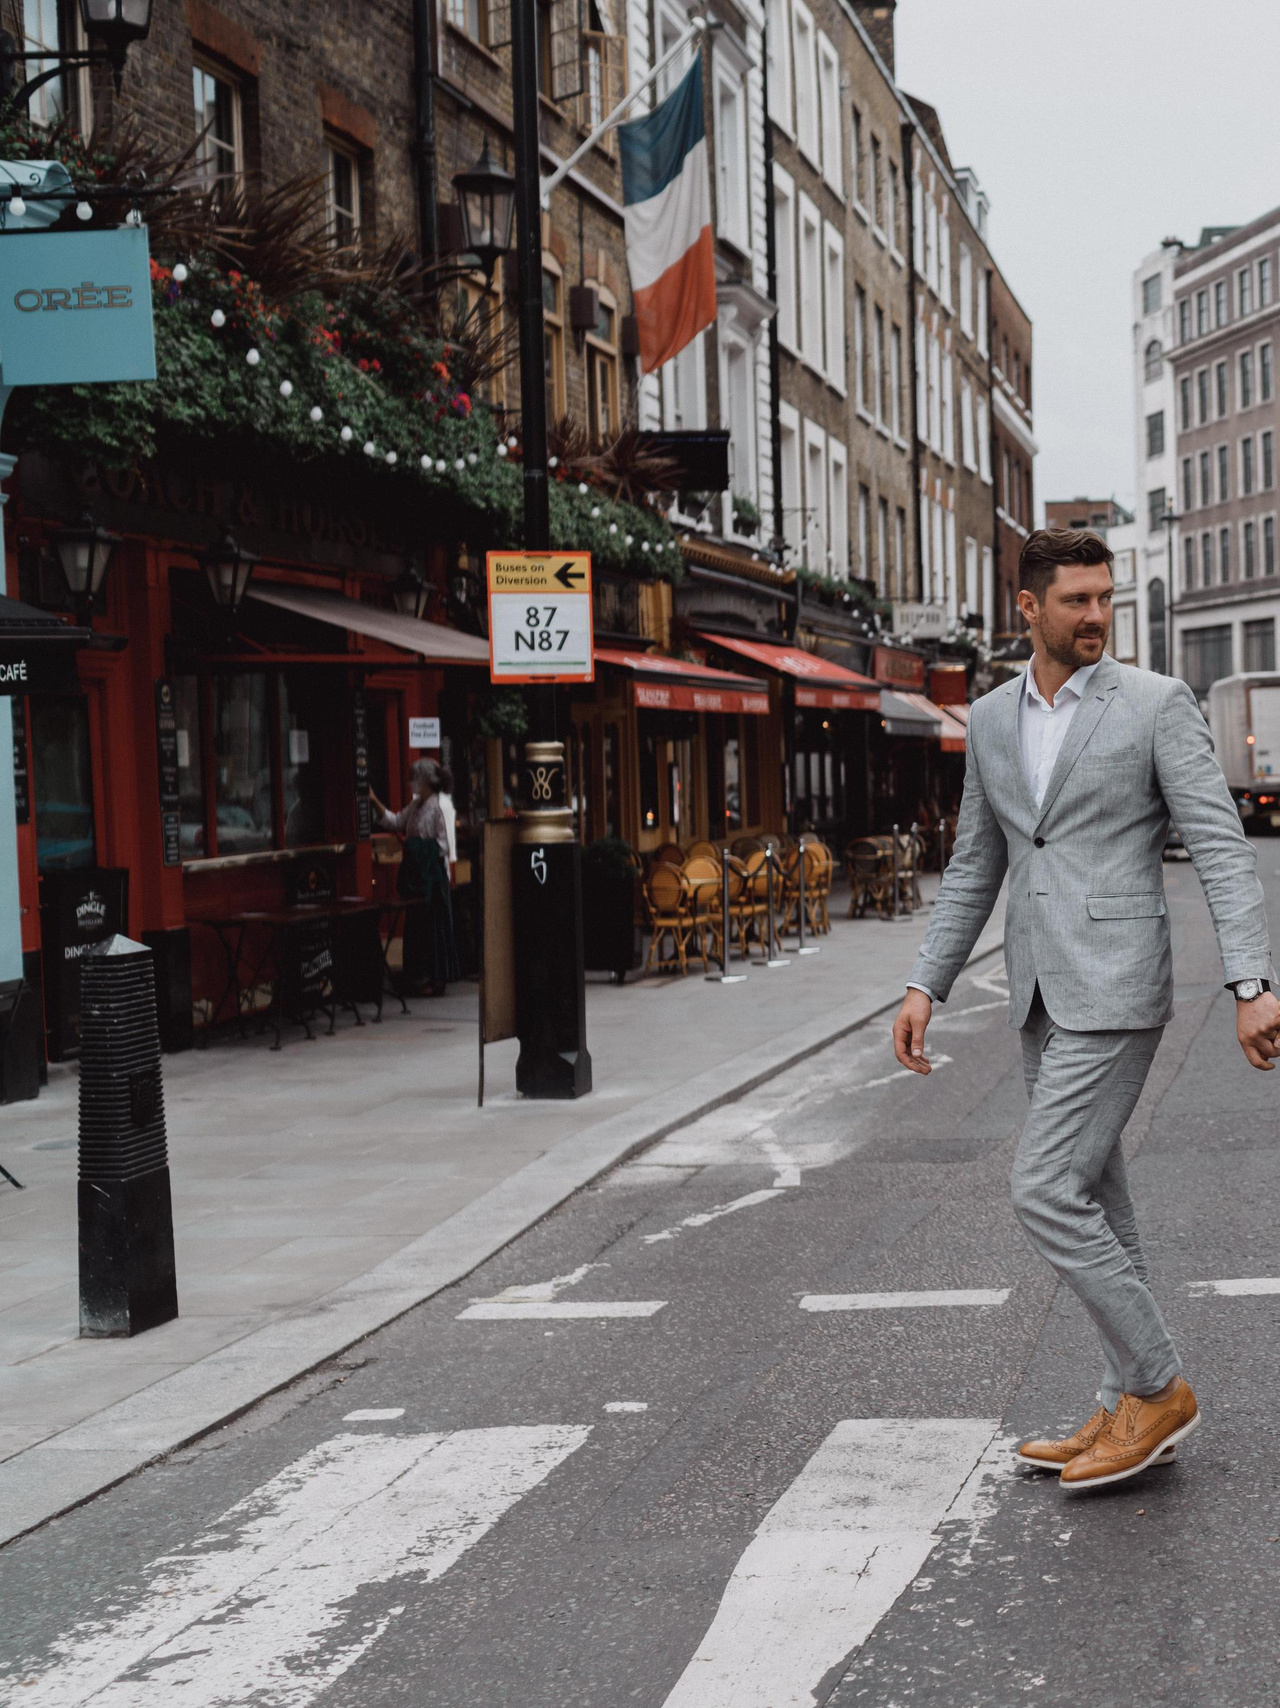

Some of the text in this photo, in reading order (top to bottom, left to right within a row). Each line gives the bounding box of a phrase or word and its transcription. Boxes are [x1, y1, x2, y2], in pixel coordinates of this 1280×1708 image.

[495, 562, 545, 573] Buses on
[495, 575, 548, 585] Diversion
[525, 606, 558, 628] 87
[514, 629, 570, 652] N87
[0, 659, 28, 682] CAFÉ
[75, 900, 106, 919] DINGLE
